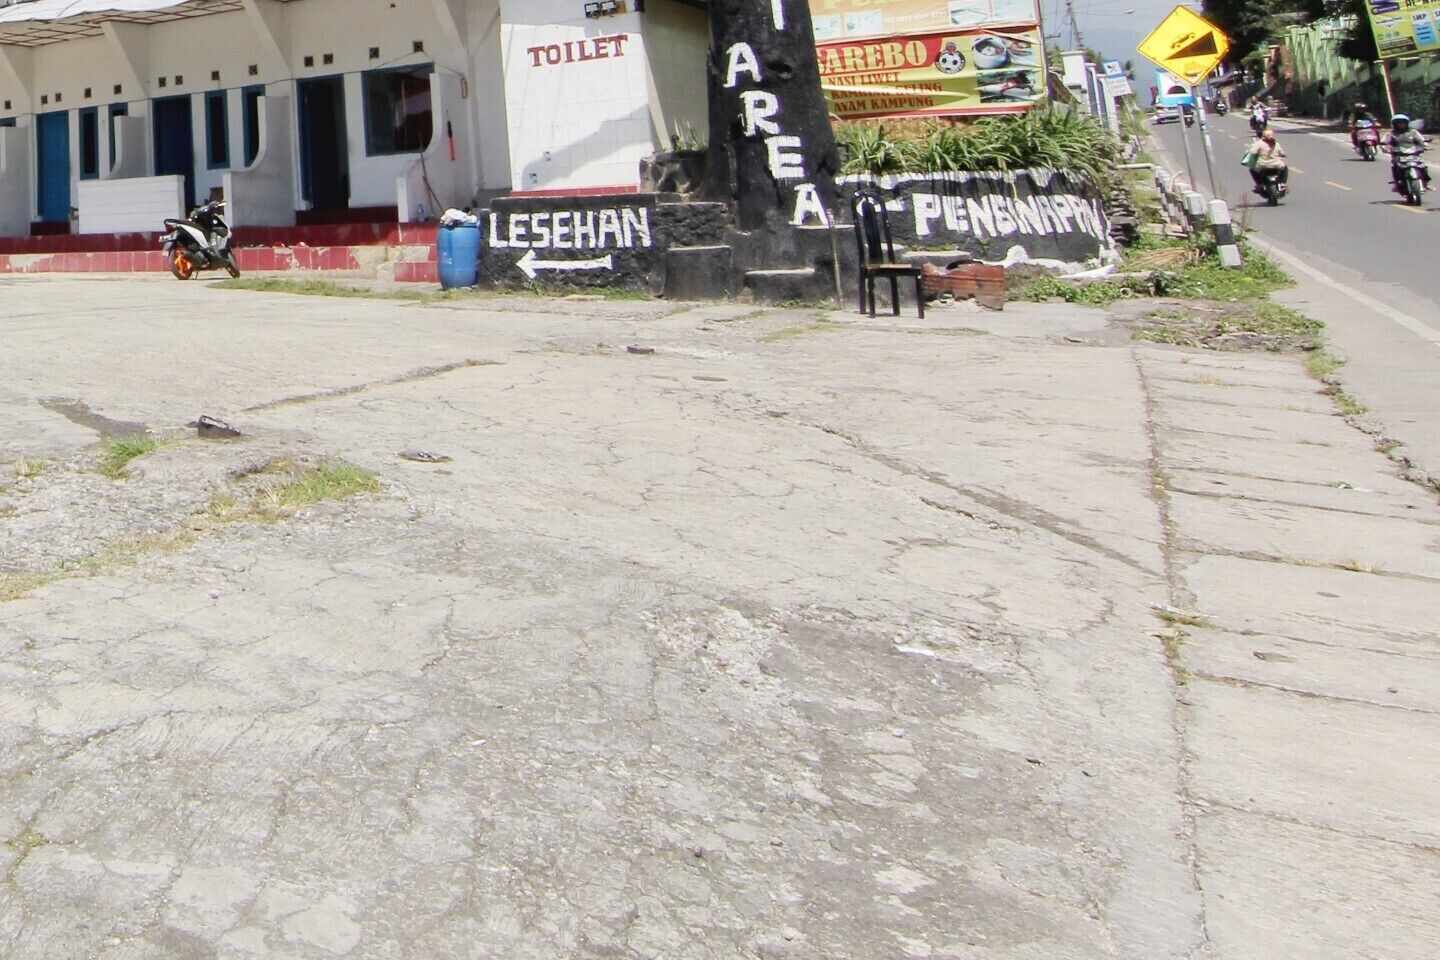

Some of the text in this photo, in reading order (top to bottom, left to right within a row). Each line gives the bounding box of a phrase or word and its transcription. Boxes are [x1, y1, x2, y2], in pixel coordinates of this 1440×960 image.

[527, 34, 628, 68] TOILET
[828, 71, 900, 87] NASI LIWET
[834, 96, 934, 113] AYAM KAMPUNG
[723, 41, 831, 227] AREA
[489, 207, 653, 250] LESEHAN
[912, 192, 1106, 242] PENGINAPAN
